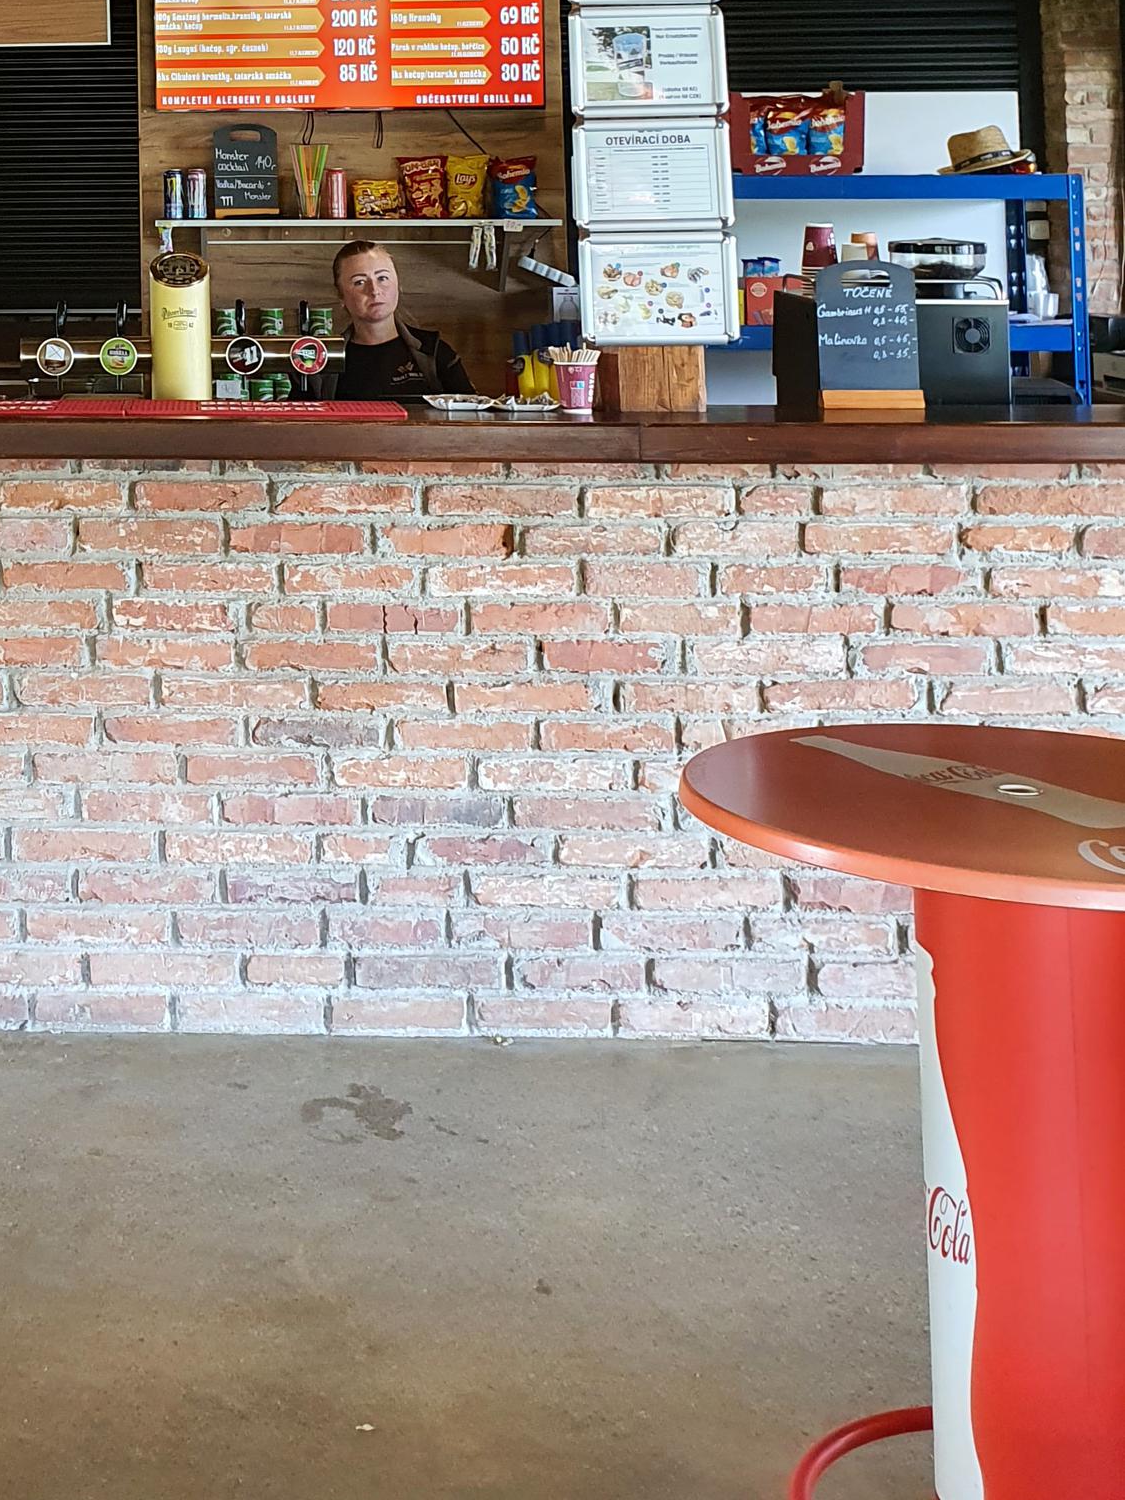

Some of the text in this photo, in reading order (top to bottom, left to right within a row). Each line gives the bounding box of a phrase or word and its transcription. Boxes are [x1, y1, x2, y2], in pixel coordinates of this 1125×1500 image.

[331, 6, 377, 27] 200 KČ
[500, 3, 539, 24] 69 KČ
[333, 35, 376, 56] 120 KČ
[501, 33, 540, 55] 50 KČ
[339, 60, 378, 82] 85 KČ
[501, 60, 540, 81] 30 KČ
[162, 95, 315, 105] KOMPLETNÍ ALERGENY U OBSLUHY
[416, 93, 532, 104] OBČERSTVENÍ GRILL BAR
[605, 134, 691, 146] OTEVÍRACÍ DOBA
[217, 161, 249, 172] cocktail
[843, 284, 893, 298] TOČENÉ
[817, 303, 863, 318] Gambrinus
[818, 333, 867, 347] Malinovka
